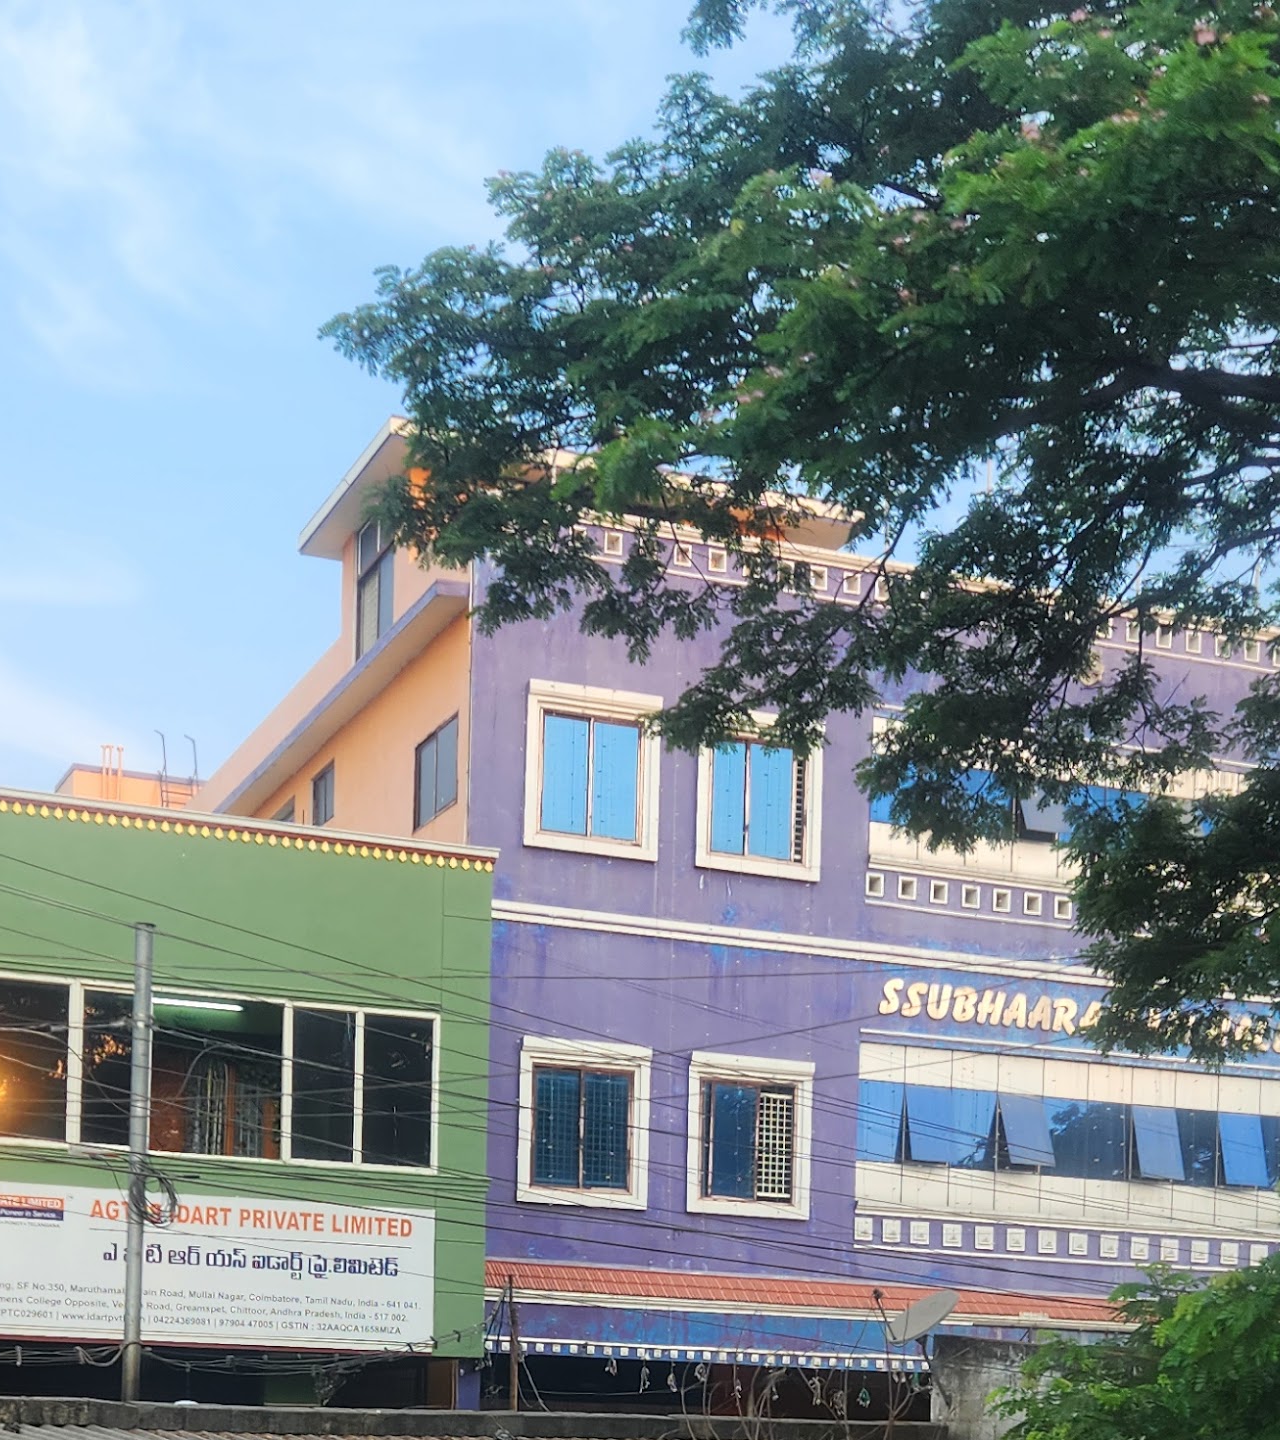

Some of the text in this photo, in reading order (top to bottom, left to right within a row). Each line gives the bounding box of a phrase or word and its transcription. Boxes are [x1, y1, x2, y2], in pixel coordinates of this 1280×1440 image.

[21, 1195, 62, 1209] LIMITED
[239, 1208, 325, 1232] PRIVATE
[331, 1213, 413, 1238] LIMITED
[159, 1290, 186, 1299] Road,
[218, 1292, 247, 1302] Nagar,
[248, 1293, 303, 1305] Coimbatore,
[305, 1295, 328, 1305] Tamil
[330, 1297, 356, 1307] Nadu,
[358, 1298, 379, 1308] India
[26, 1296, 62, 1307] College
[64, 1298, 110, 1309] Opposite,
[146, 1302, 173, 1312] Road,
[230, 1305, 268, 1316] Chittoor,
[270, 1307, 302, 1317] Andhra
[304, 1309, 343, 1320] Pradesh,
[344, 1311, 366, 1320] India
[374, 1312, 389, 1321] 517
[280, 1321, 309, 1331] GSTIN
